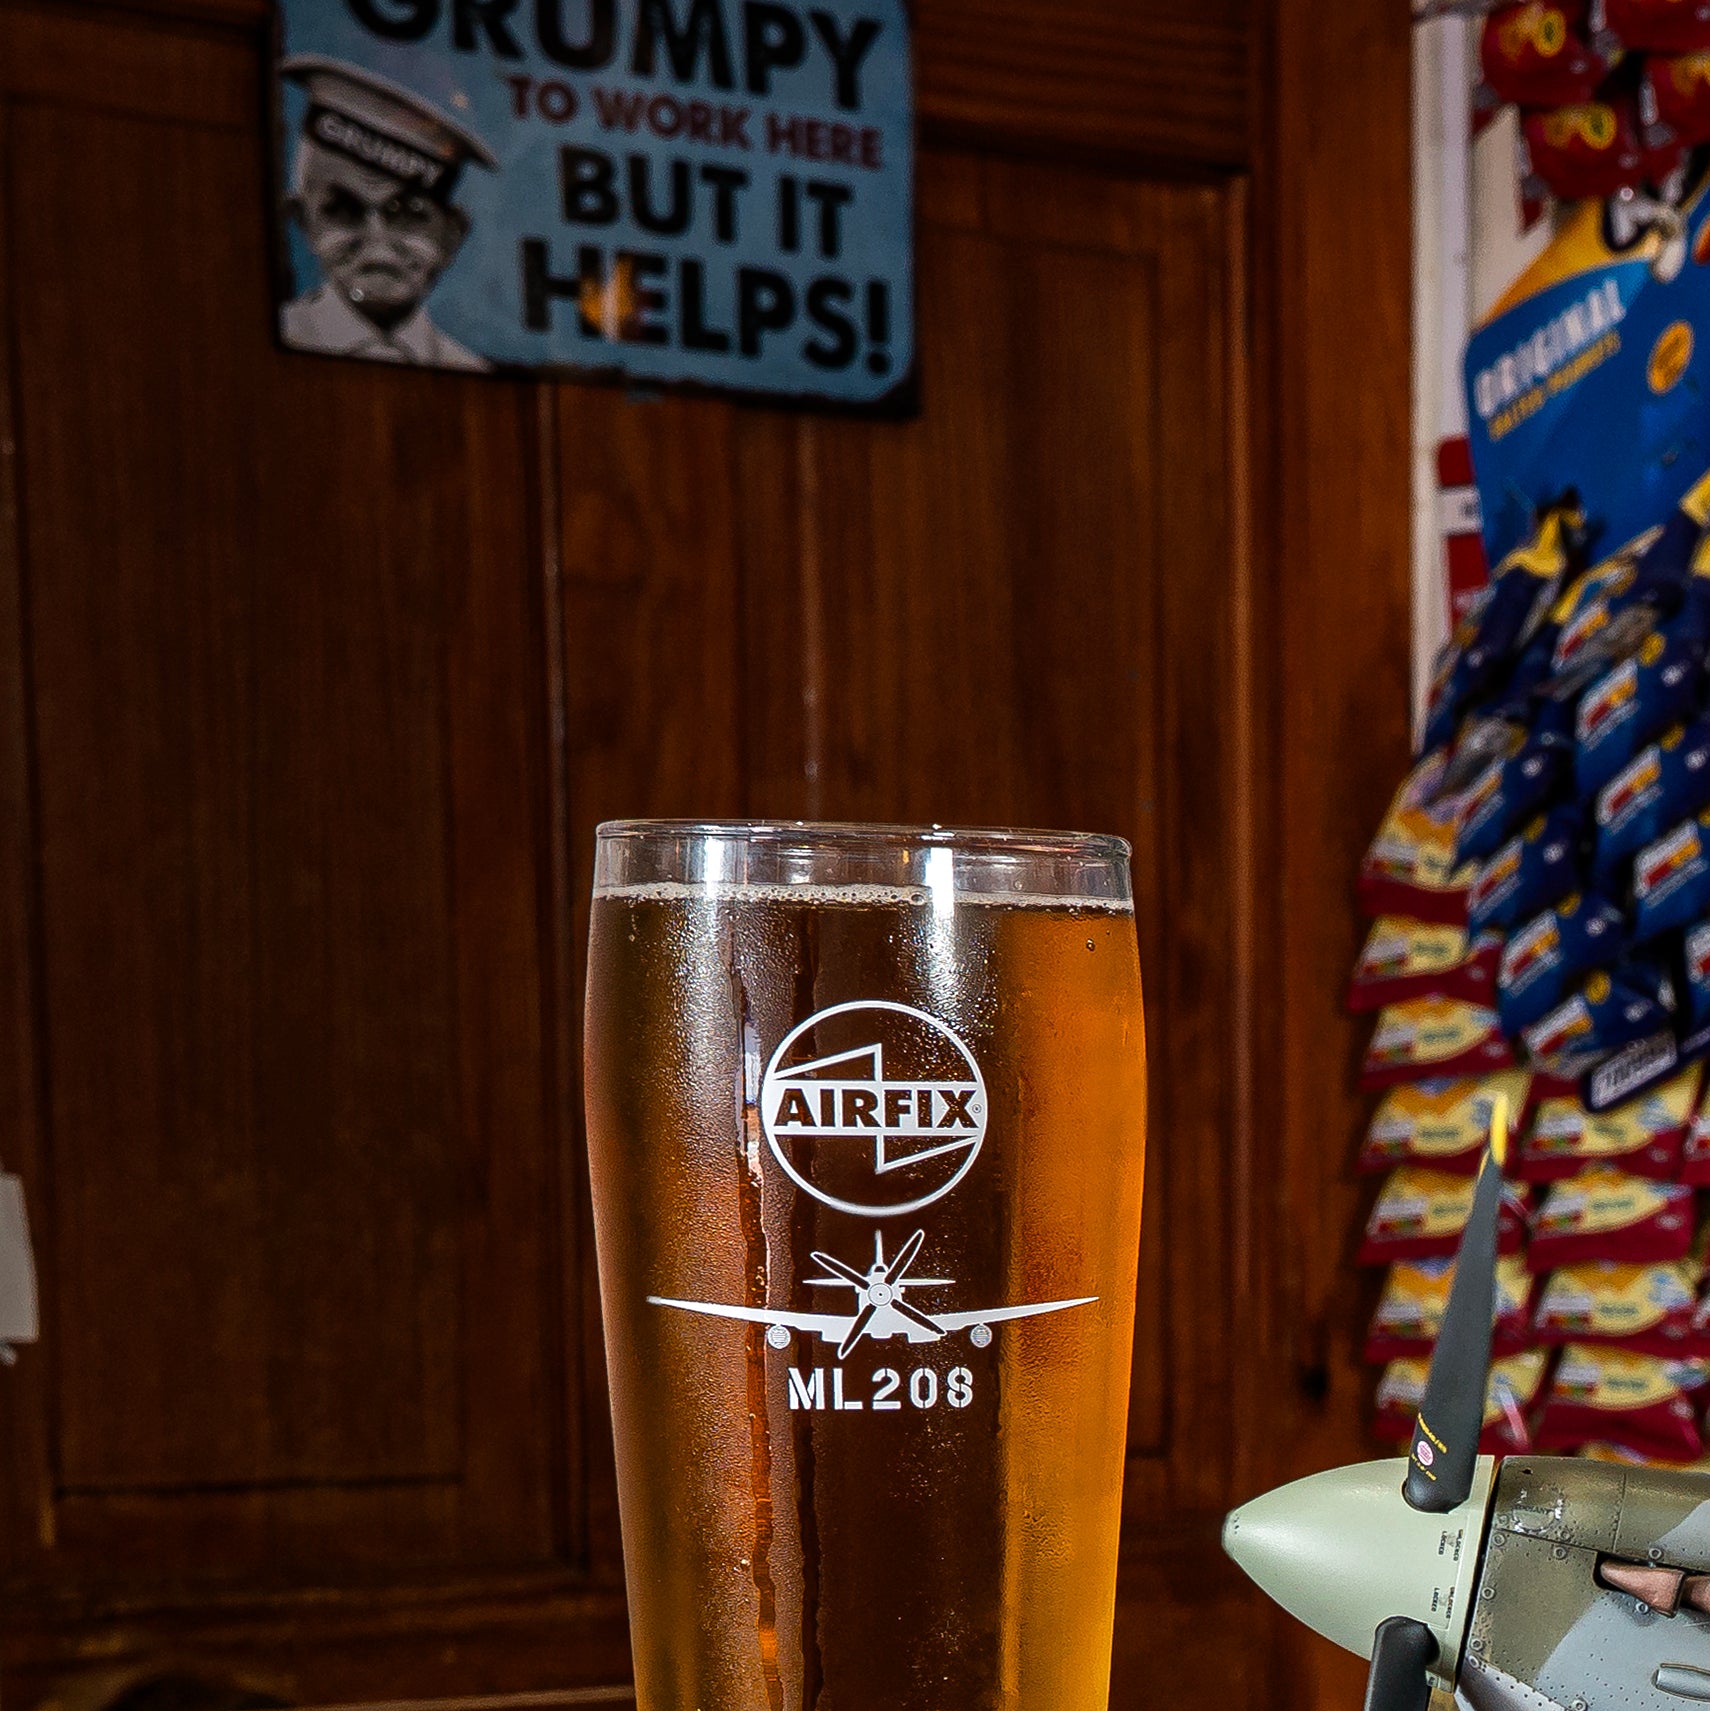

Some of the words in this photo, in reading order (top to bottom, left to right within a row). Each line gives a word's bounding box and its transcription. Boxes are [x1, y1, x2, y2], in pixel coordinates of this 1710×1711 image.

[508, 74, 580, 125] TO
[591, 86, 751, 151] WORK
[766, 114, 883, 171] HERE
[559, 144, 751, 245] BUT
[775, 176, 854, 260] IT
[519, 238, 893, 378] HELPS!
[774, 1088, 981, 1130] AIRFIX
